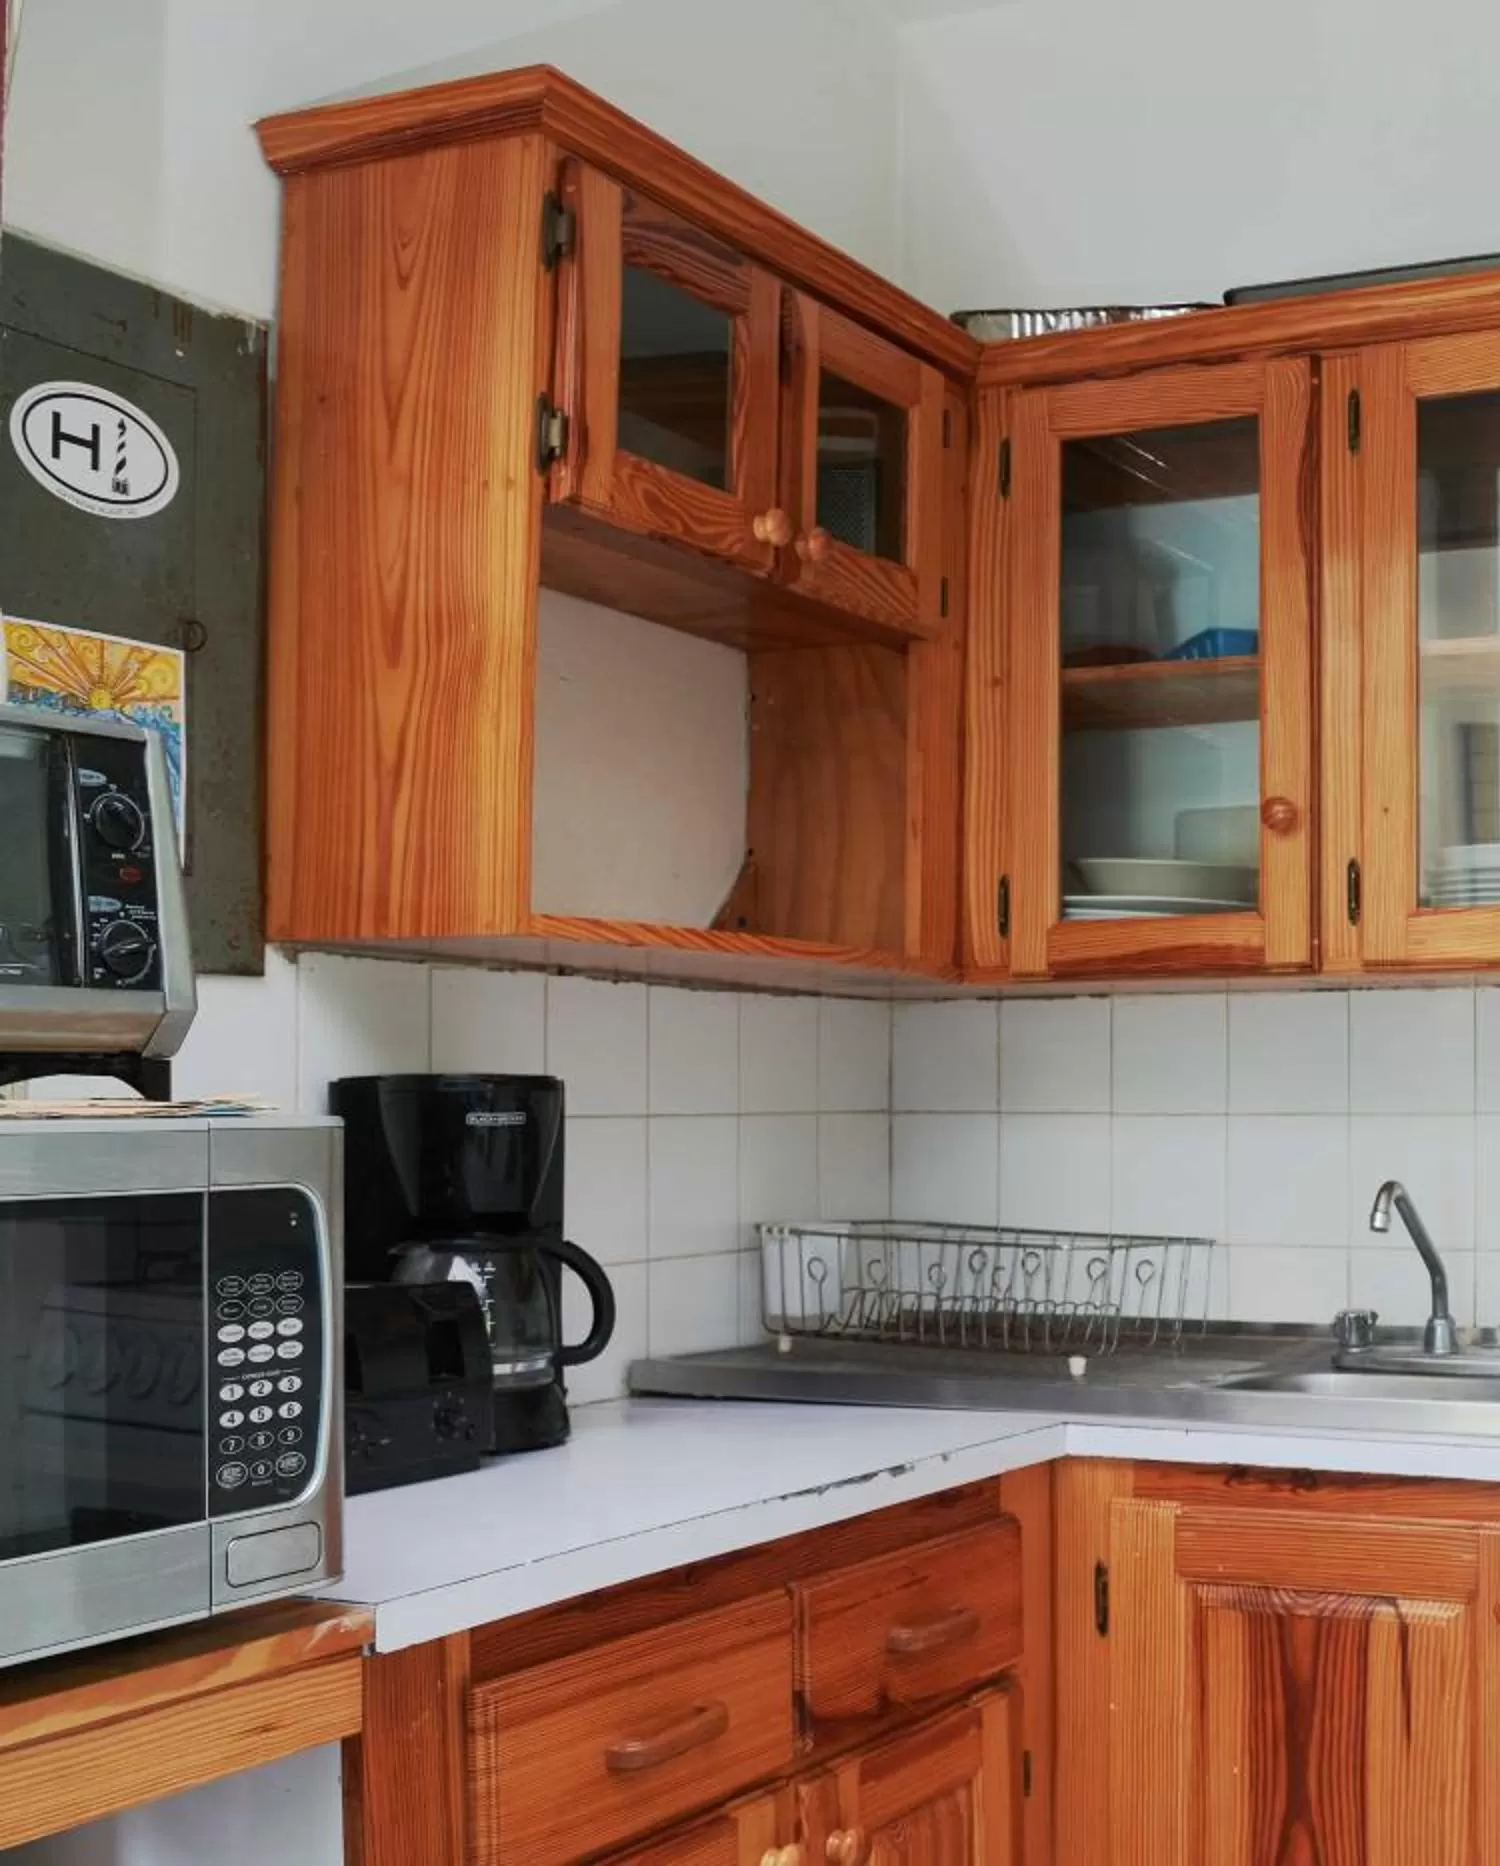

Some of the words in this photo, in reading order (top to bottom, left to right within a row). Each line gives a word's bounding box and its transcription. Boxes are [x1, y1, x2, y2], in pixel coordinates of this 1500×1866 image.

[228, 1387, 236, 1399] 1
[257, 1382, 265, 1395] 2
[287, 1378, 295, 1391] 3
[227, 1413, 236, 1425] 4
[257, 1407, 265, 1421] 5
[287, 1403, 295, 1417] 6
[229, 1439, 236, 1451] 7
[257, 1434, 266, 1446] 8
[287, 1429, 295, 1441] 9
[257, 1463, 265, 1475] 0
